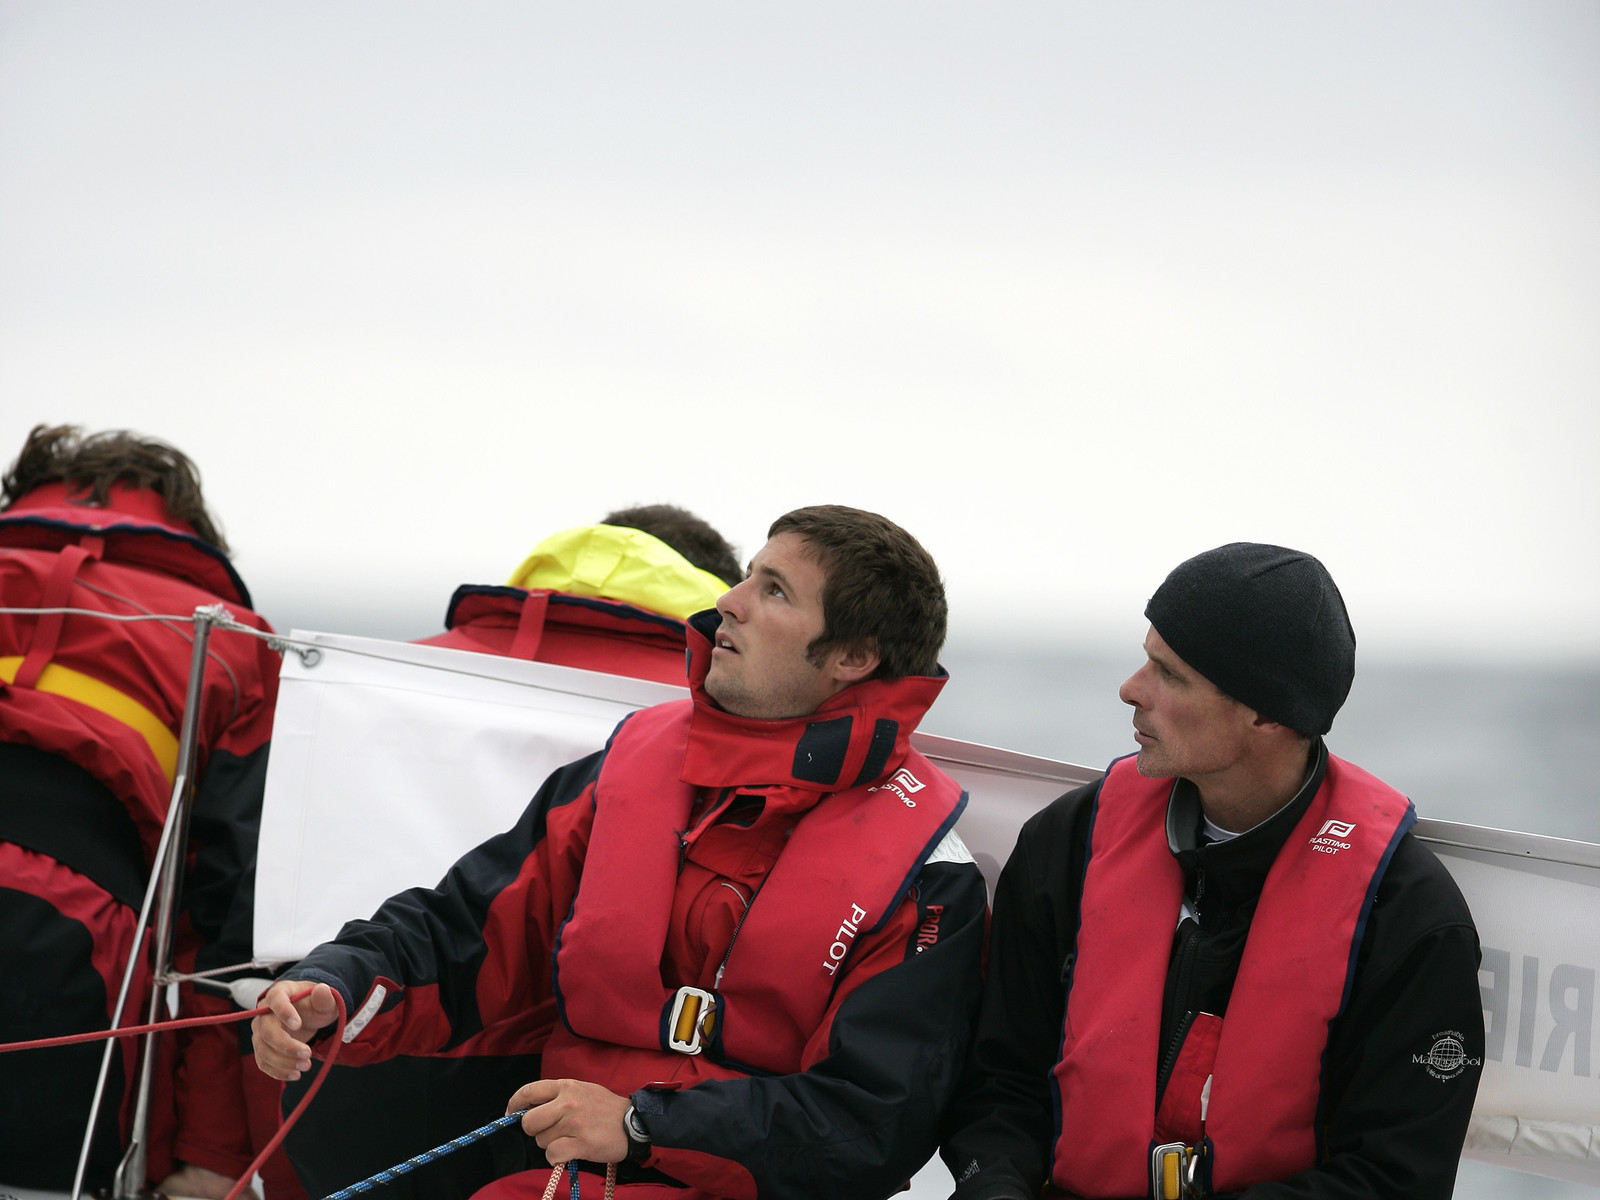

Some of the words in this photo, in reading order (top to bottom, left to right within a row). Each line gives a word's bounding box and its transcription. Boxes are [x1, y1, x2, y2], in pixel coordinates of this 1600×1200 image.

[867, 783, 917, 808] PASTIMO
[1308, 837, 1351, 850] PLASTIMO
[1312, 844, 1339, 855] PILOT
[822, 902, 867, 976] PILOT
